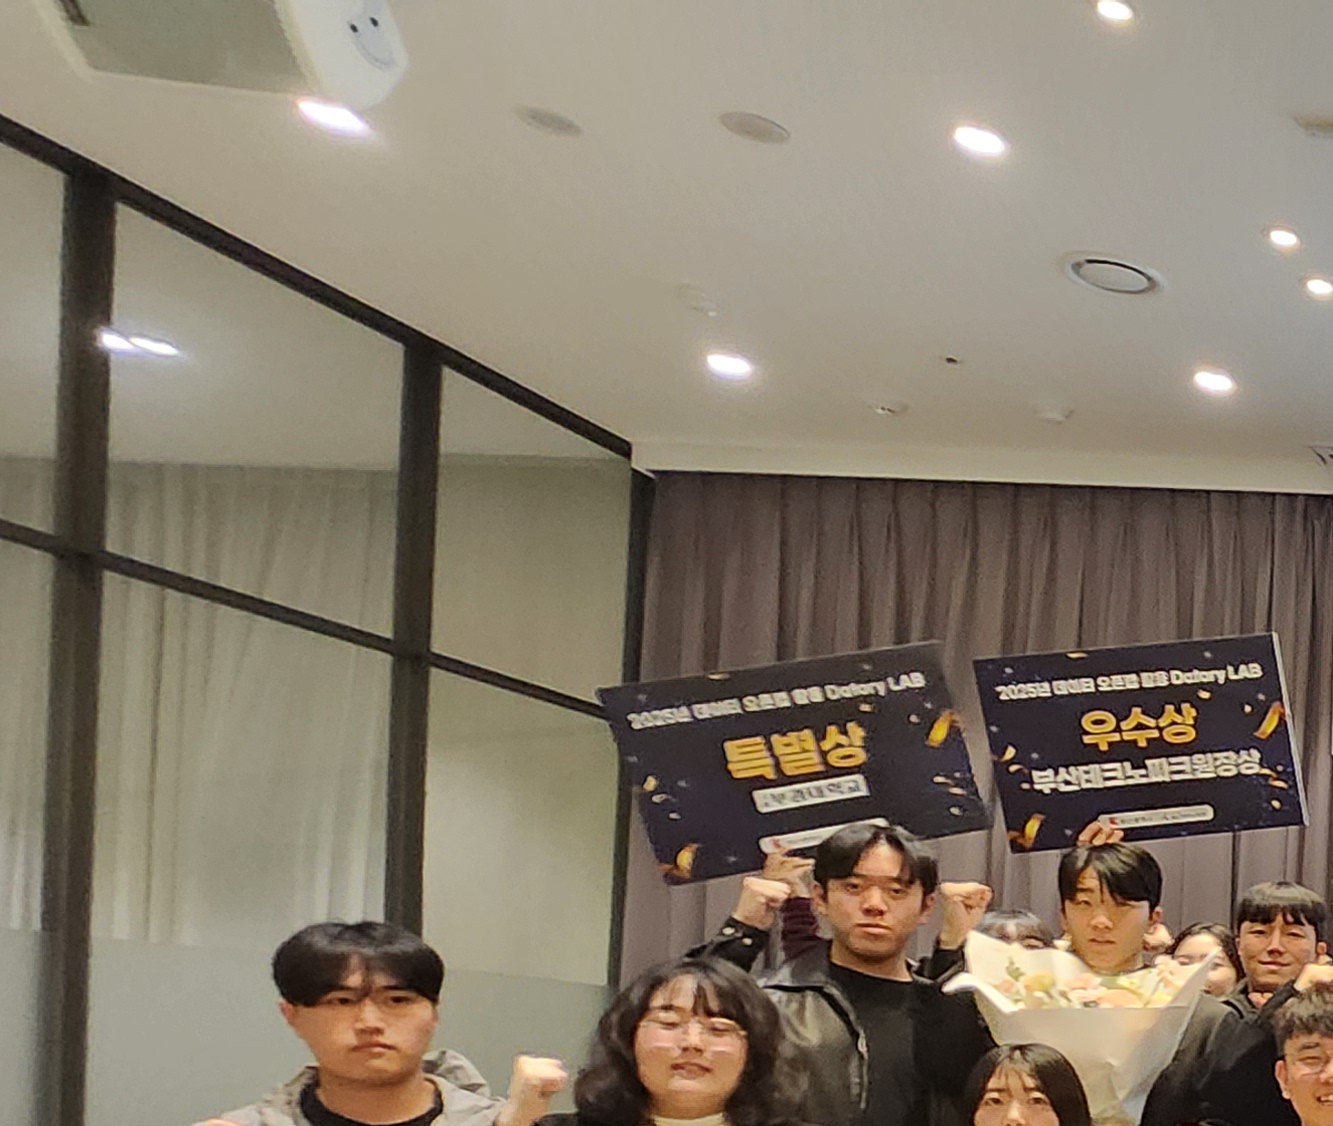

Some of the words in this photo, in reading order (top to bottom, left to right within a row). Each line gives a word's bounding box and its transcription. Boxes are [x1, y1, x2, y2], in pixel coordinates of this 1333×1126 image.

[723, 721, 867, 780] 특별상
[1080, 702, 1198, 752] 우수상
[1031, 748, 1262, 794] 부산테크노파크원장상
